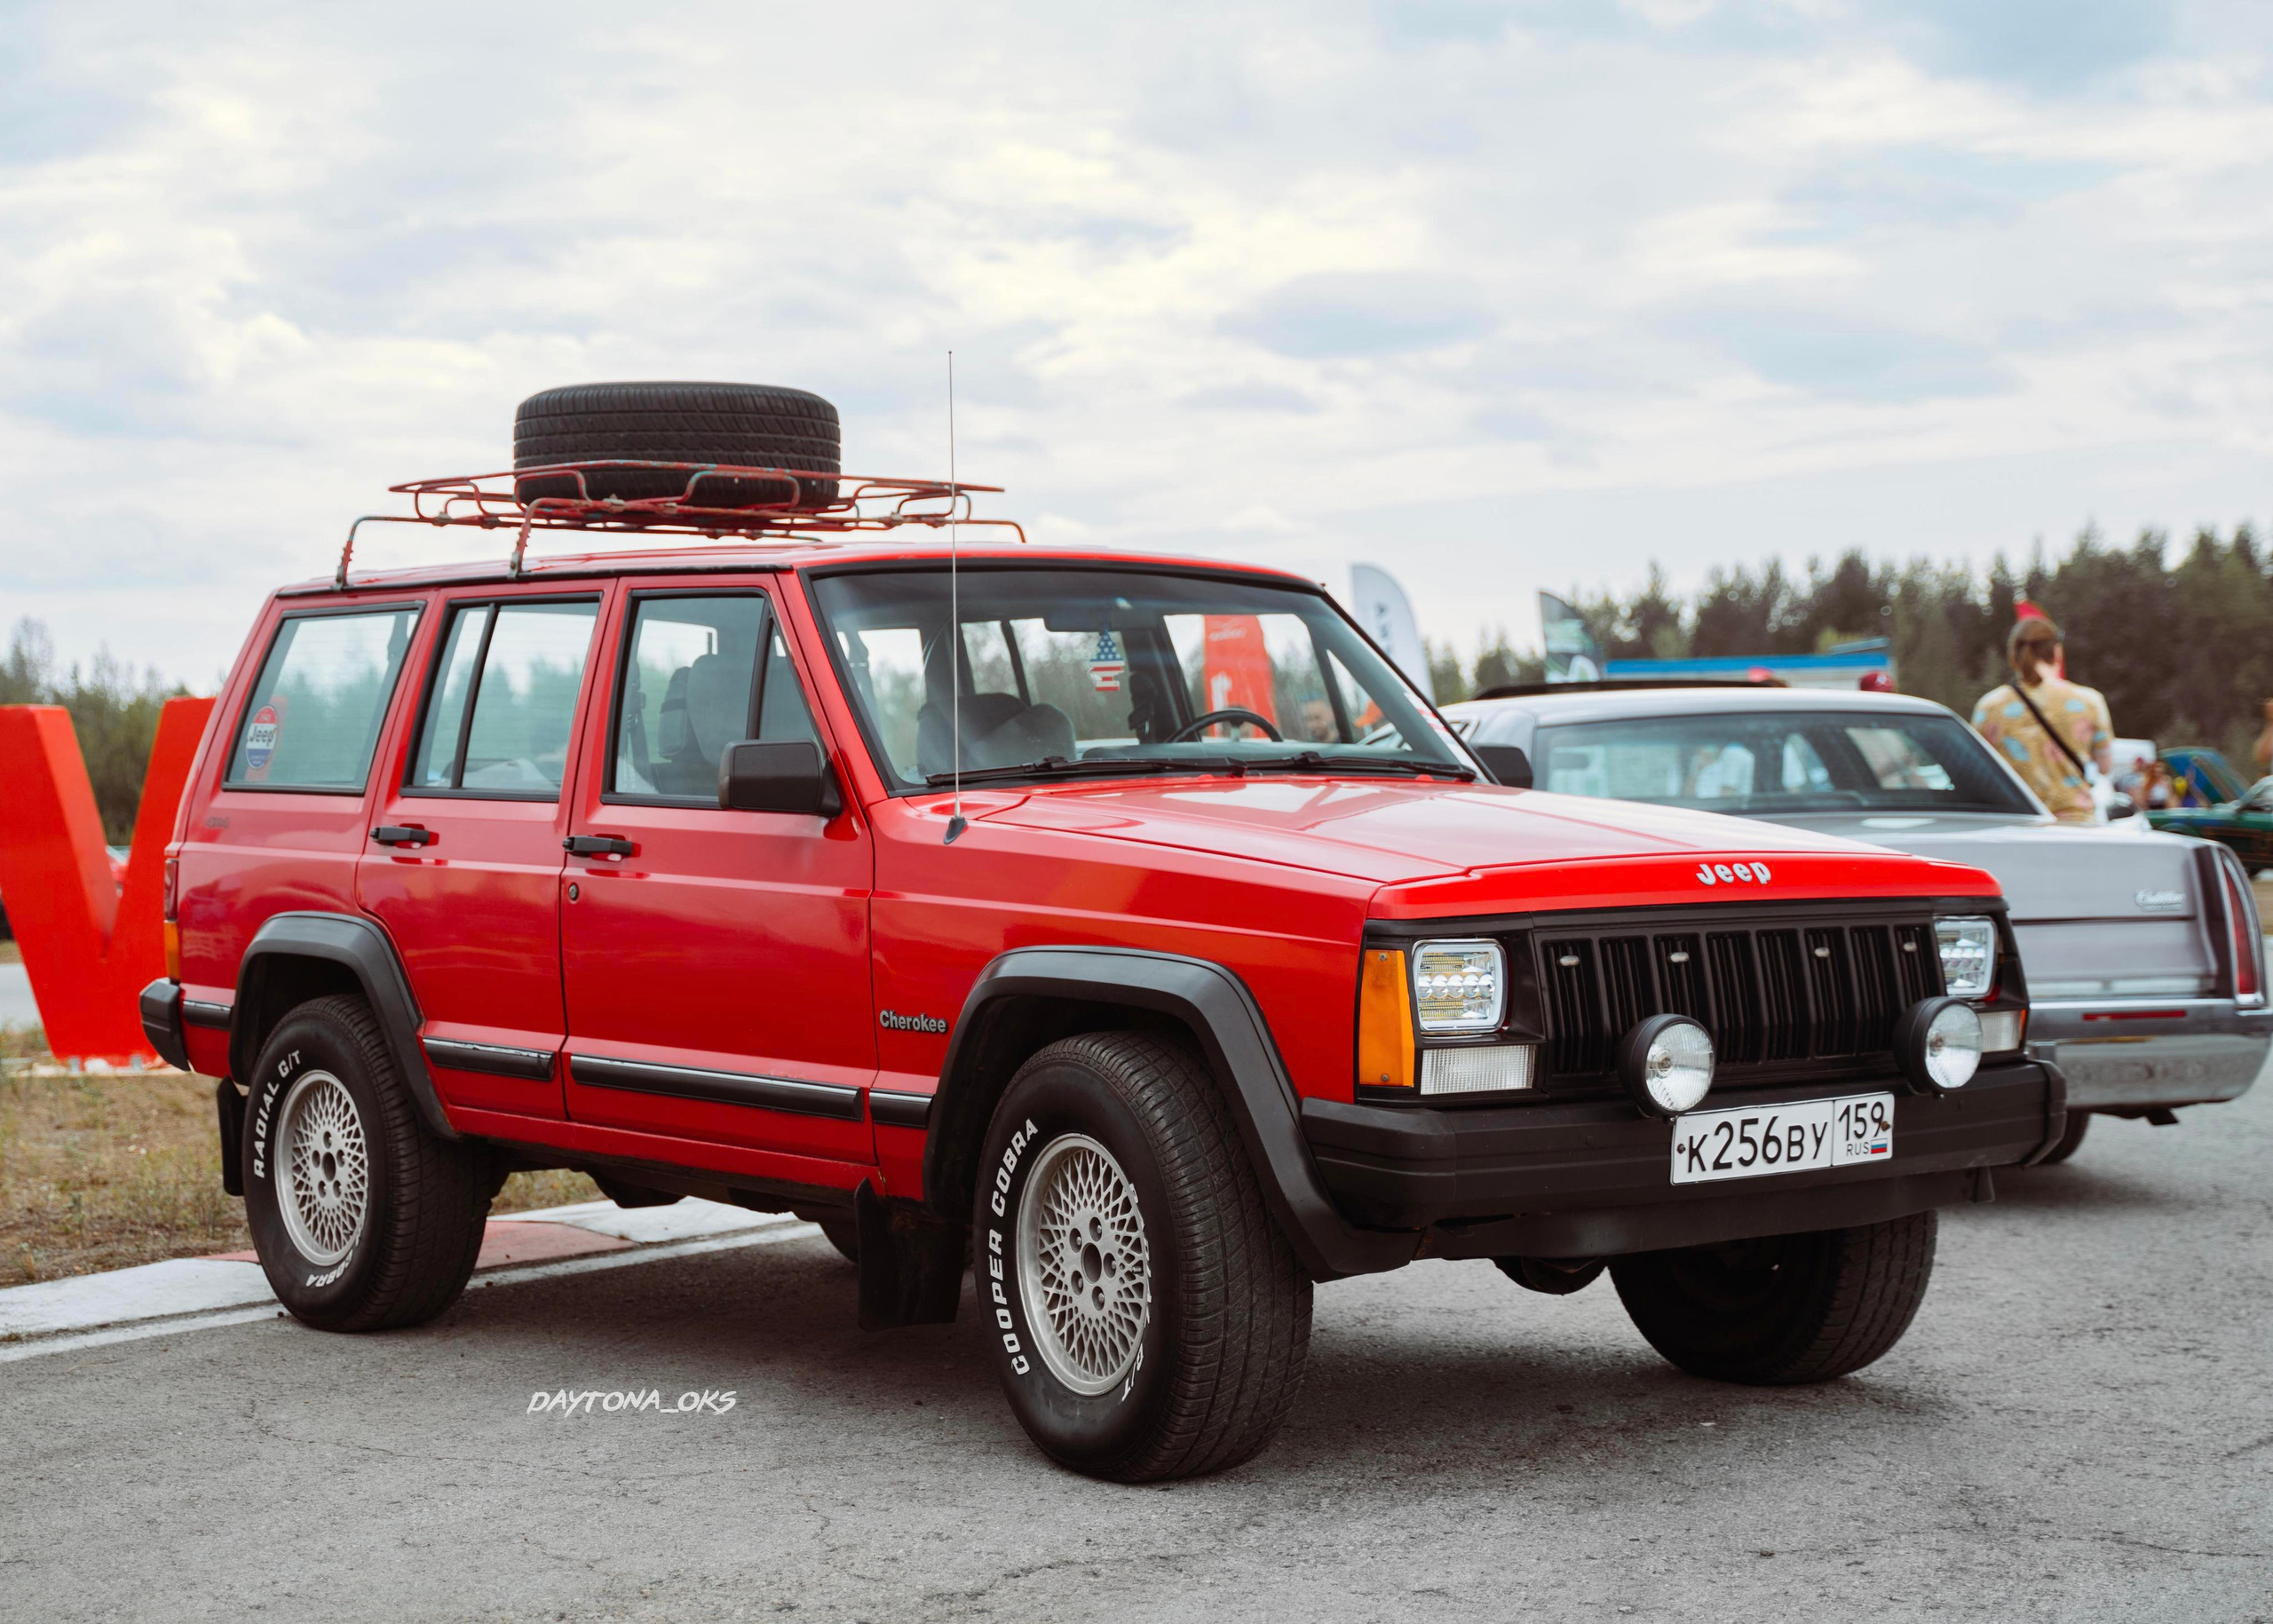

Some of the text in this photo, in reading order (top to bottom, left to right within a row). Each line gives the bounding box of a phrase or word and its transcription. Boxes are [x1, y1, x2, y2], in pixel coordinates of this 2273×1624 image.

[247, 725, 276, 747] Jeep
[1696, 862, 1771, 886] Jeep
[879, 1009, 947, 1034] Cherokee
[253, 1050, 301, 1179] RADIAL G/T
[1838, 1101, 1886, 1142] 159
[1846, 1141, 1870, 1157] RUS
[988, 1119, 1039, 1376] COOPER COBRA
